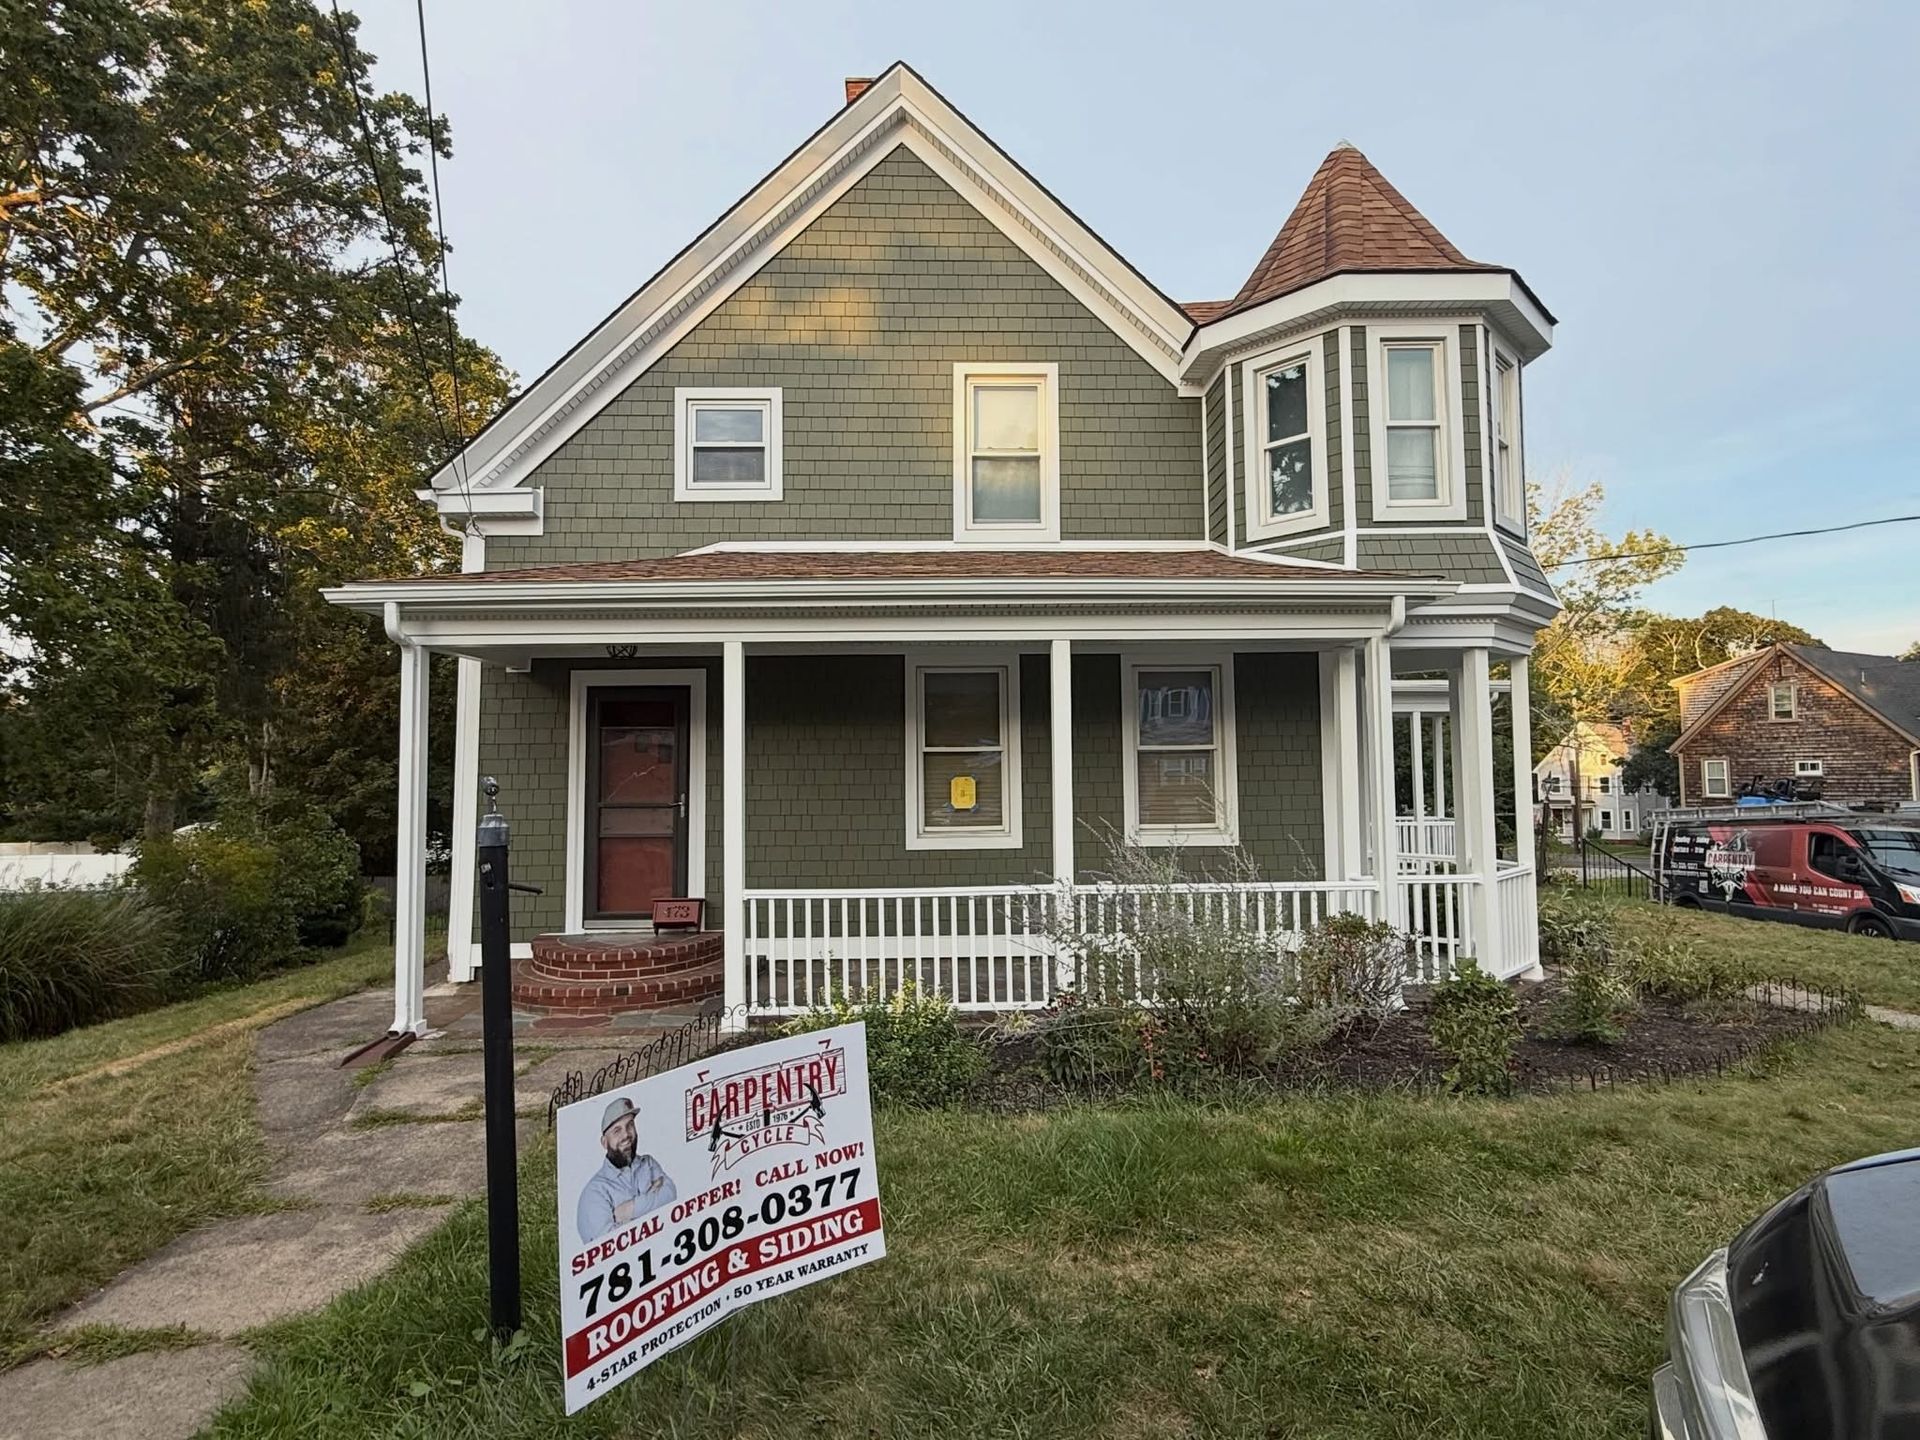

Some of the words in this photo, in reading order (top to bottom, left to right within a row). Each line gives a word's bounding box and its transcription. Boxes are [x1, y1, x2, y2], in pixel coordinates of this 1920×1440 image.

[1707, 852, 1753, 867] CARPENTRY
[1780, 884, 1797, 894] NAME
[1799, 885, 1812, 895] YOU
[1813, 886, 1828, 896] CAN
[1829, 888, 1852, 898] COUNT
[692, 1057, 837, 1132] CARPENTRY
[746, 1120, 761, 1132] ESTD
[772, 1111, 788, 1123] 1976
[741, 1127, 794, 1154] CYCLE
[571, 1220, 664, 1276] SPECIAL
[670, 1180, 741, 1224] OFFER!
[755, 1161, 808, 1187] CALL
[815, 1142, 865, 1168] NOW!
[579, 1168, 862, 1319] 781-308-0377
[586, 1260, 720, 1360] ROOFING
[727, 1247, 750, 1273] &
[759, 1210, 864, 1265] SIDING
[586, 1350, 638, 1391] 4-STAR
[641, 1298, 721, 1358] PROTECTION
[733, 1283, 752, 1299] 50
[755, 1269, 795, 1290] YEAR
[798, 1243, 869, 1279] WARRANTY
